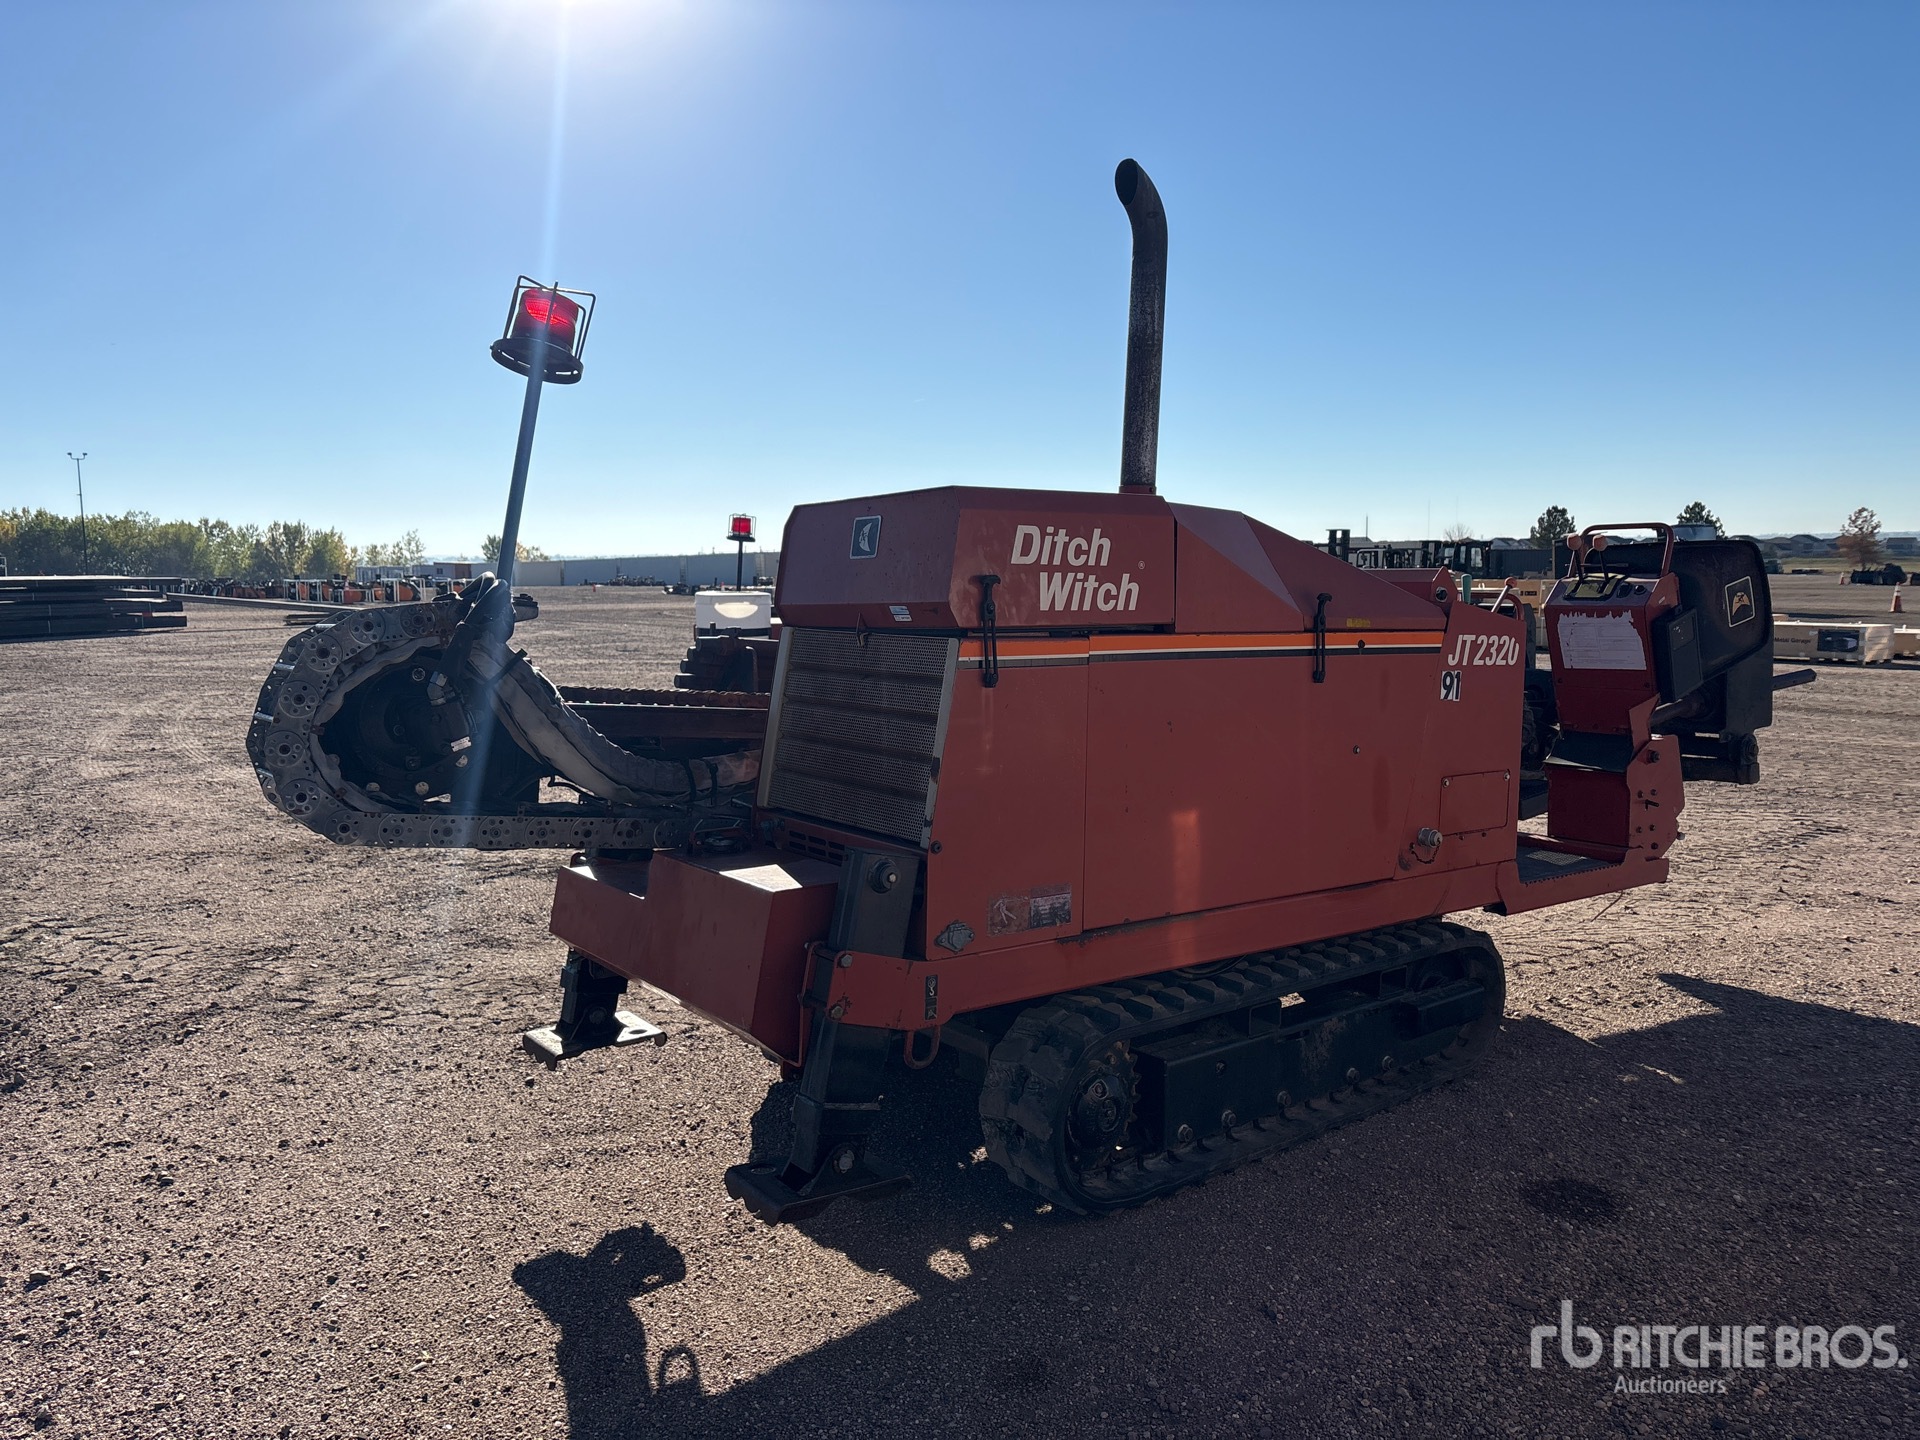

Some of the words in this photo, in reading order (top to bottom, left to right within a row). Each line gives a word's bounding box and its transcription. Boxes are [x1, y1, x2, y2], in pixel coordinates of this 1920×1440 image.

[1010, 524, 1112, 566] Ditch
[1039, 571, 1140, 611] Witch
[1447, 634, 1520, 666] JT2320
[1442, 671, 1461, 700] 91
